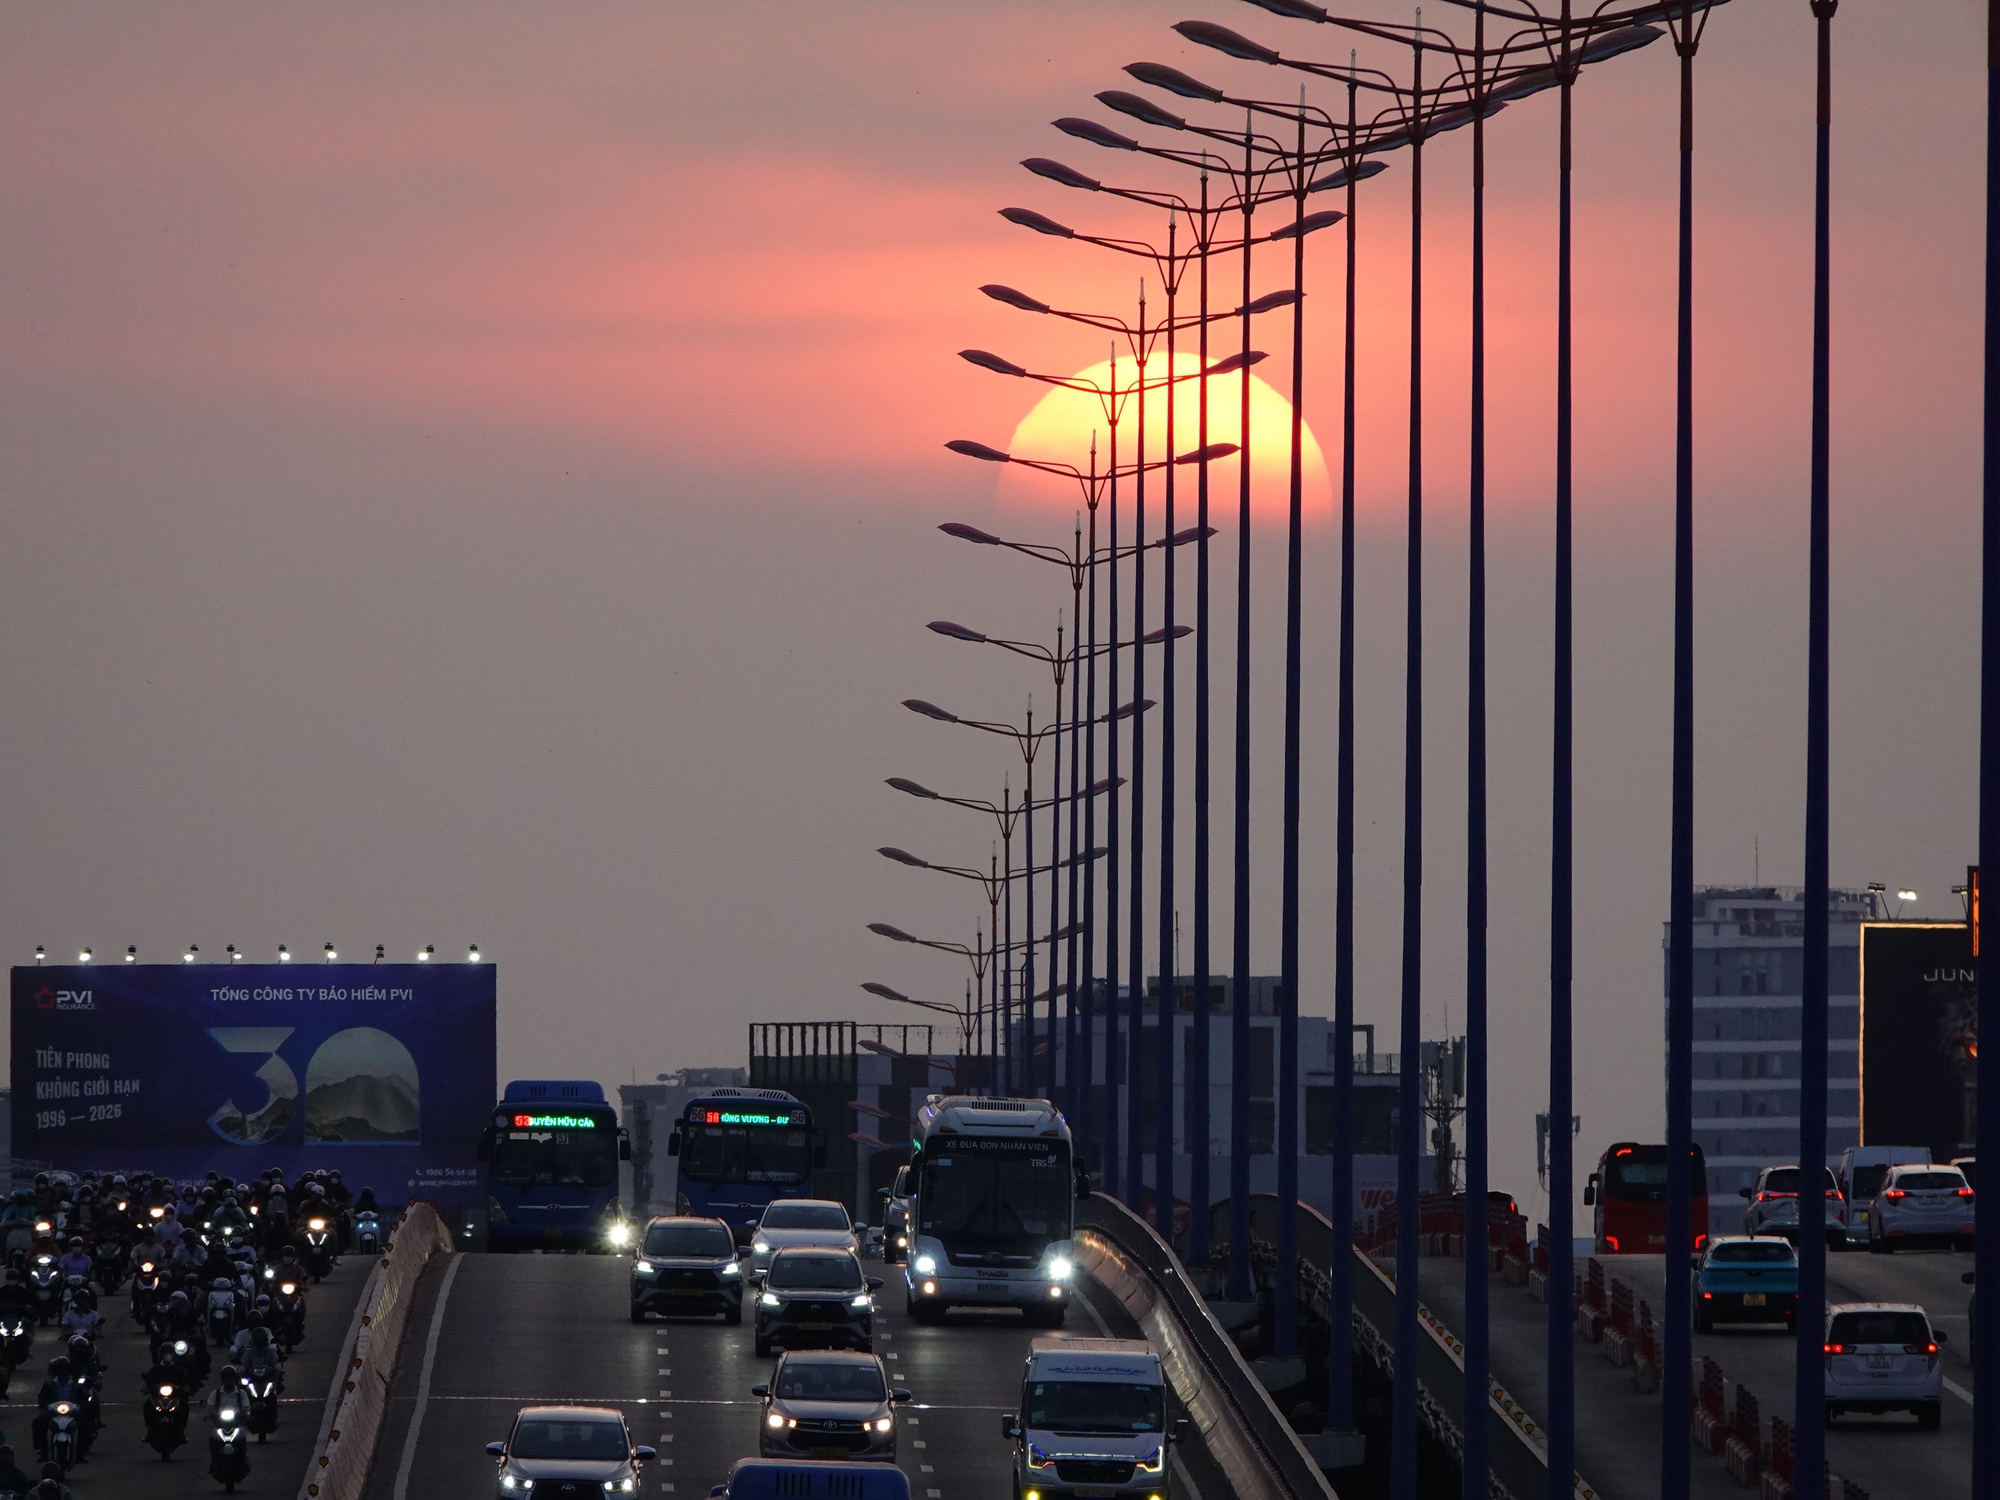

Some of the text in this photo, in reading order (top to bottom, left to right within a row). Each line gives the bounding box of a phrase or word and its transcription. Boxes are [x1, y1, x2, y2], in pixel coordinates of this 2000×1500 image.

[56, 990, 92, 1003] PVI
[210, 985, 249, 1001] TỔNG
[253, 986, 293, 1001] CÔNG
[296, 988, 315, 1001] TY
[319, 985, 347, 1001] BẢO
[390, 988, 412, 1000] PVI
[35, 1044, 110, 1069] TIÊN PHONG
[36, 1075, 140, 1100] KHÔNG GIỚI HẠN
[36, 1109, 66, 1129] 1996
[89, 1103, 122, 1122] 2026
[515, 1115, 530, 1126] 53
[691, 1108, 704, 1120] 56
[706, 1111, 719, 1123] 56
[792, 1110, 804, 1123] 56
[946, 1140, 957, 1149] XE
[1030, 1158, 1047, 1168] TBS
